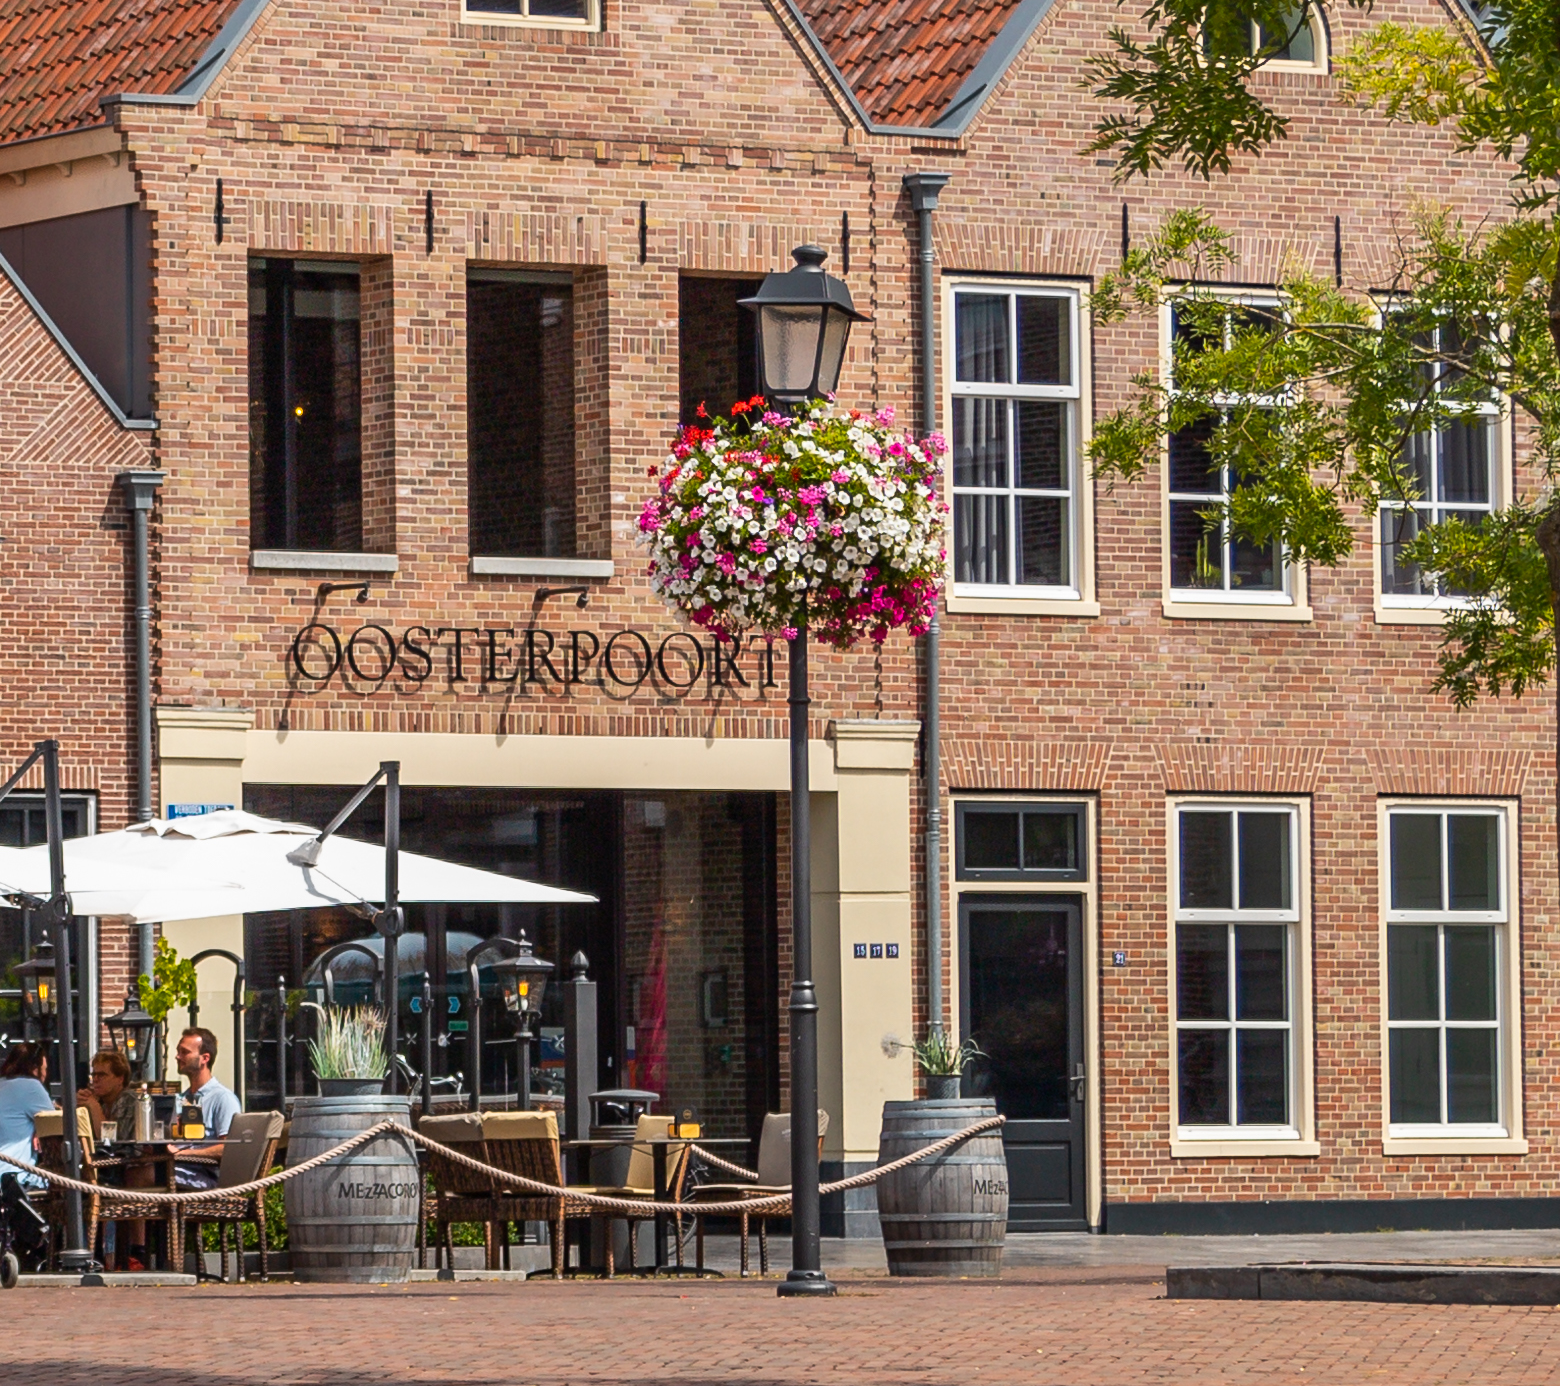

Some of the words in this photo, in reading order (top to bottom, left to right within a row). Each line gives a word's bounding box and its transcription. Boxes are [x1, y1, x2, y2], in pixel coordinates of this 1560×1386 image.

[293, 623, 779, 689] OOSTERPOORT
[856, 945, 865, 956] 15
[872, 945, 881, 956] 17
[888, 945, 897, 956] 19
[338, 1182, 418, 1200] MEZZACORO
